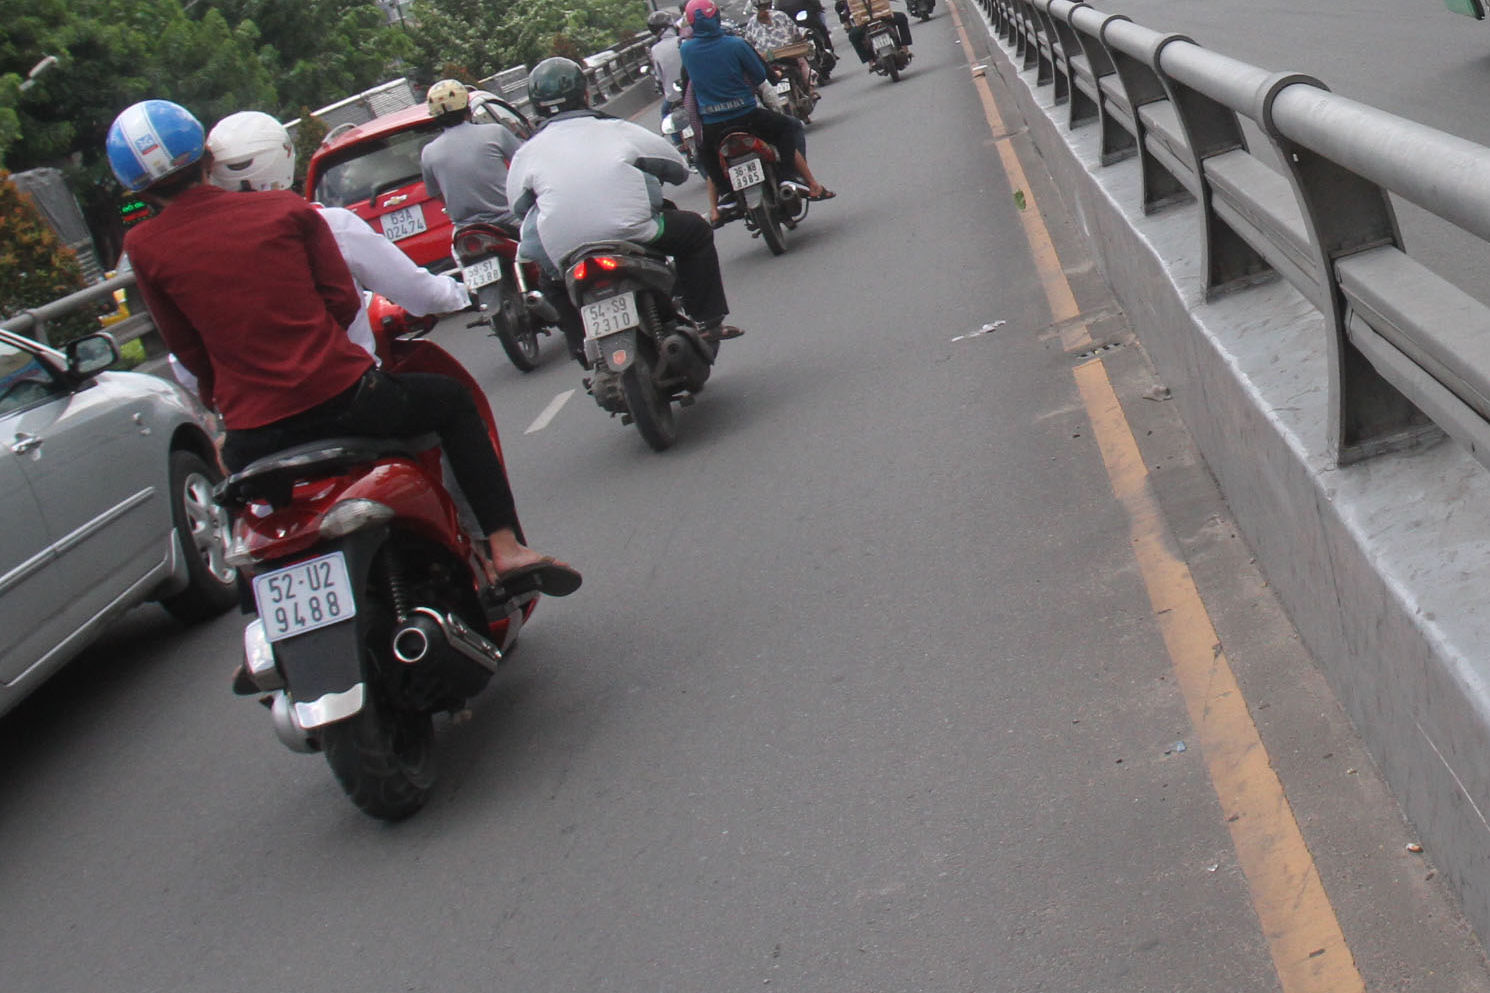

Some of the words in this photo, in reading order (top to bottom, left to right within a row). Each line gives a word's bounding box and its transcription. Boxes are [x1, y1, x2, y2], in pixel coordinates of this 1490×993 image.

[390, 209, 413, 225] 63A
[386, 220, 424, 240] 02474
[589, 297, 627, 320] 54-S9
[593, 312, 630, 336] 2310
[268, 561, 334, 603] 52-U2
[275, 591, 340, 632] 9488
